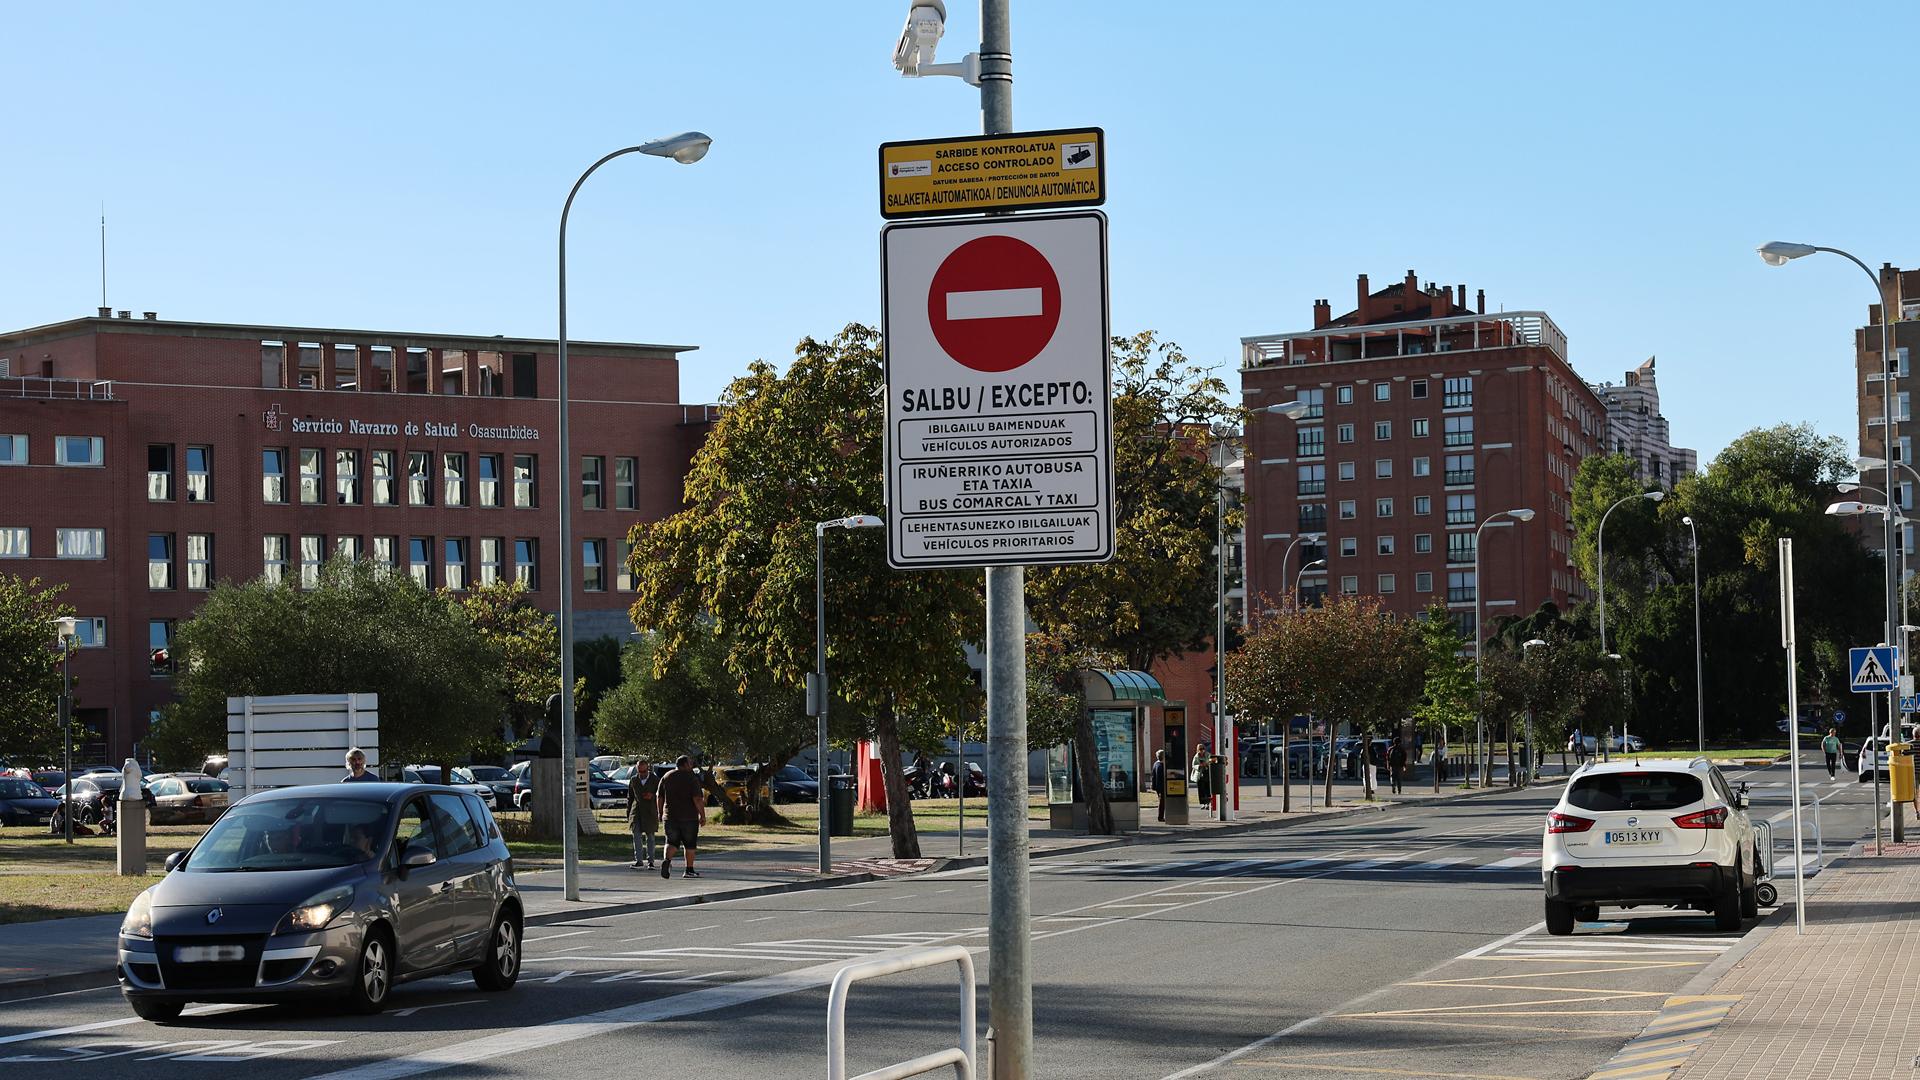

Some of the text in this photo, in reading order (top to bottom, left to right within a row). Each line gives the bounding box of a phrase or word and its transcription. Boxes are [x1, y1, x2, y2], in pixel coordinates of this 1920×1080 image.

[936, 143, 1056, 159] SARBIDE KONTROLATUA
[938, 162, 979, 172] ACCESO
[983, 157, 1054, 169] CONTROLADO
[888, 179, 1096, 207] SALAKETA AUTOMATIKOA / DENUNCIA AUTOMÁTICA
[902, 381, 1092, 413] SALBU / EXCEPTO:
[292, 418, 539, 440] Servicio Navarro de Salud Osasunbidea
[928, 419, 1066, 434] IBILGAILU BAIMENDUAK
[922, 437, 1072, 452] VEHÍCULOS AUTORIZADOS
[913, 462, 1083, 479] IRUÑERRIKO AUTOBUSA
[963, 478, 1033, 491] ETA TAXIA
[919, 494, 1078, 510] BUS COMARCAL Y TAXI
[907, 517, 1090, 533] LEHENTASUNEZKO IBILGAILUAK
[923, 536, 1074, 550] VEHÍCULOS PRIORITARIOS
[1612, 832, 1660, 842] 0513 KYY
[0, 1040, 347, 1062] BUS
